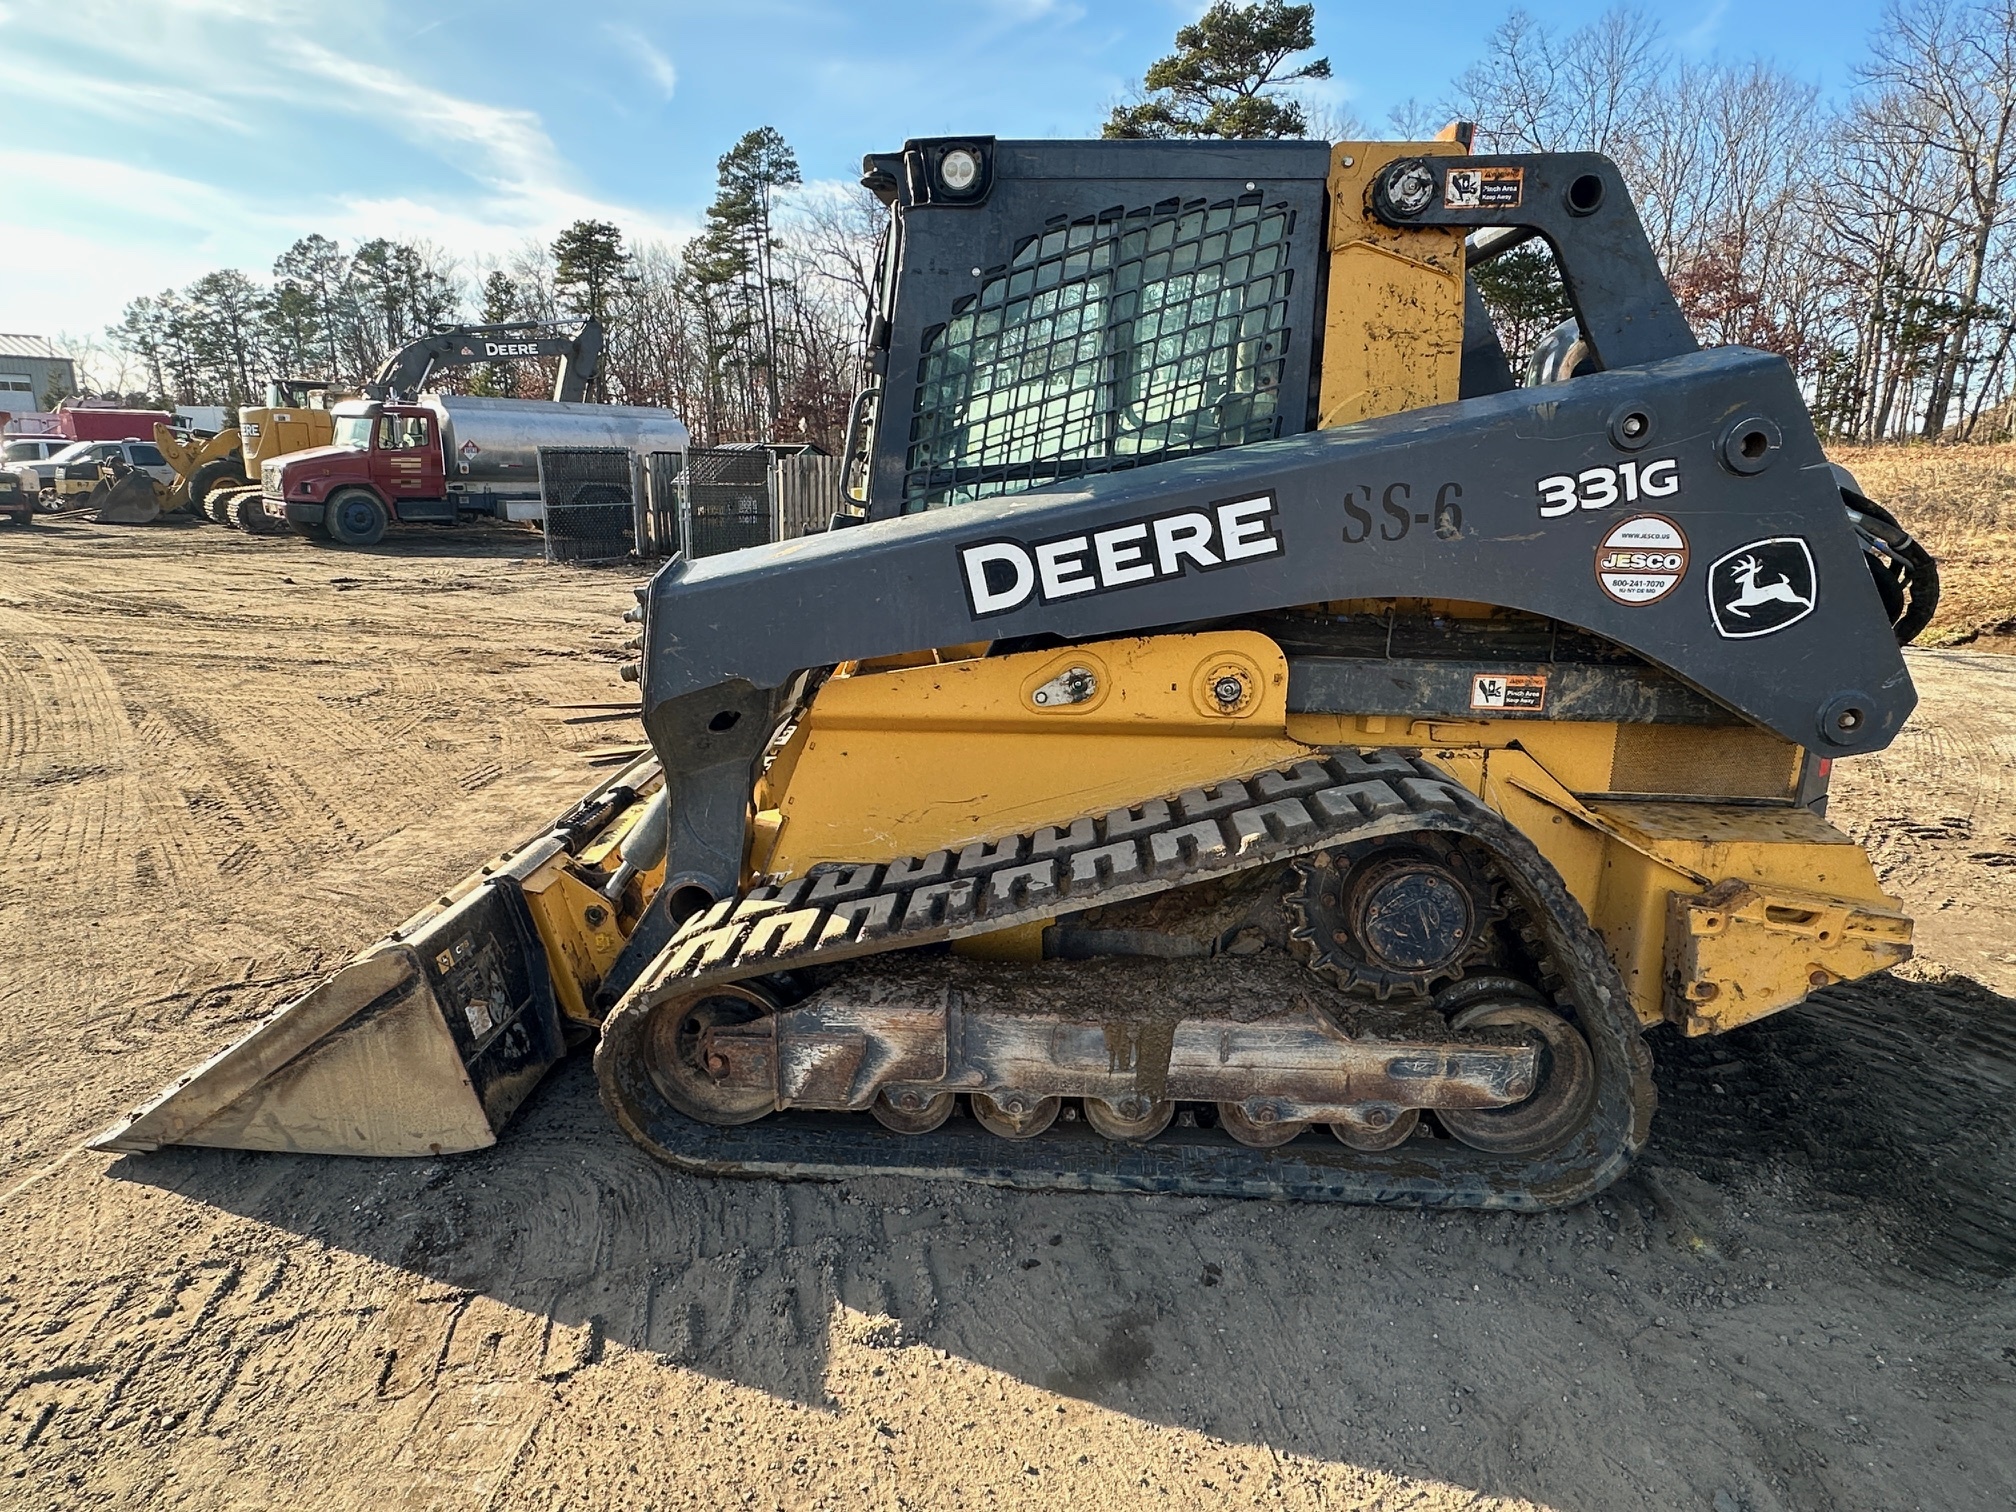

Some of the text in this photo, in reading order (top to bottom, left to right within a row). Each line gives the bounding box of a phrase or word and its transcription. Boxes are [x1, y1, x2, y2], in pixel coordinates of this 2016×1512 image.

[485, 343, 538, 356] DEERE
[1538, 459, 1678, 518] 331G
[1343, 482, 1462, 544] SS-6
[962, 496, 1278, 614] DEERE
[1602, 553, 1682, 569] JESCO
[1612, 579, 1665, 588] 800-241-7070
